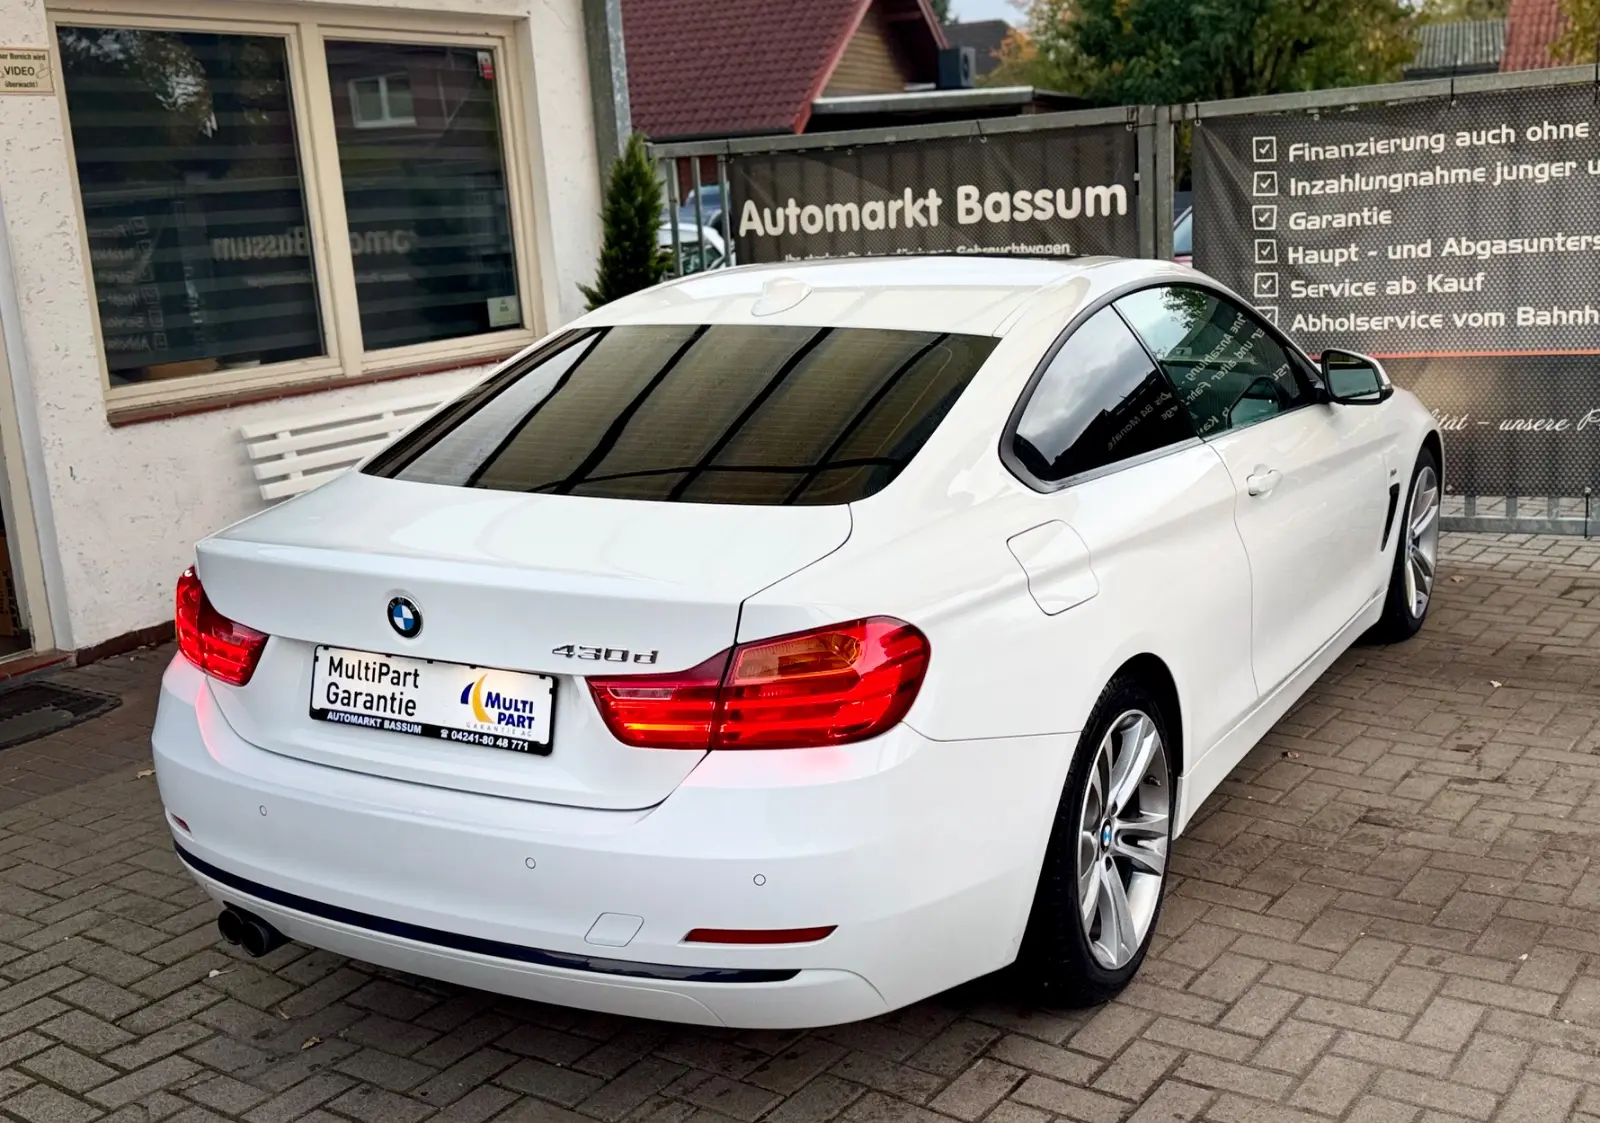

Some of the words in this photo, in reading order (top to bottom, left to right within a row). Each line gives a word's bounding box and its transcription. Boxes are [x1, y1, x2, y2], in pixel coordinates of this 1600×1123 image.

[4, 66, 35, 76] VIDEO
[1288, 133, 1445, 162] Finanzierung
[1455, 123, 1516, 147] auch
[1526, 120, 1589, 142] ohne
[1290, 165, 1486, 197] Inzahlungnahme
[1493, 160, 1577, 186] junger
[738, 187, 943, 238] Automarkt
[956, 183, 1128, 226] Bassum
[1288, 206, 1393, 231] Garantie
[1287, 243, 1360, 267] Haupt
[1387, 238, 1432, 260] und
[1440, 232, 1600, 260] Abgasunters
[1290, 278, 1377, 299] Service
[1385, 275, 1417, 295] ab
[1427, 272, 1485, 293] Kauf
[1290, 310, 1444, 332] Abholservice
[1452, 312, 1506, 328] vom
[1516, 305, 1599, 327] Bahnh
[1499, 417, 1573, 432] unsere
[551, 644, 659, 665] 430d
[328, 655, 420, 689] MultiPart
[326, 681, 417, 717] Garantie
[484, 691, 534, 714] MULTI
[327, 711, 382, 727] AUTOMARKT
[383, 720, 422, 734] BASSUM
[497, 711, 535, 729] PART
[451, 730, 494, 746] 04241-80
[496, 738, 509, 748] 48
[511, 740, 529, 751] 771
